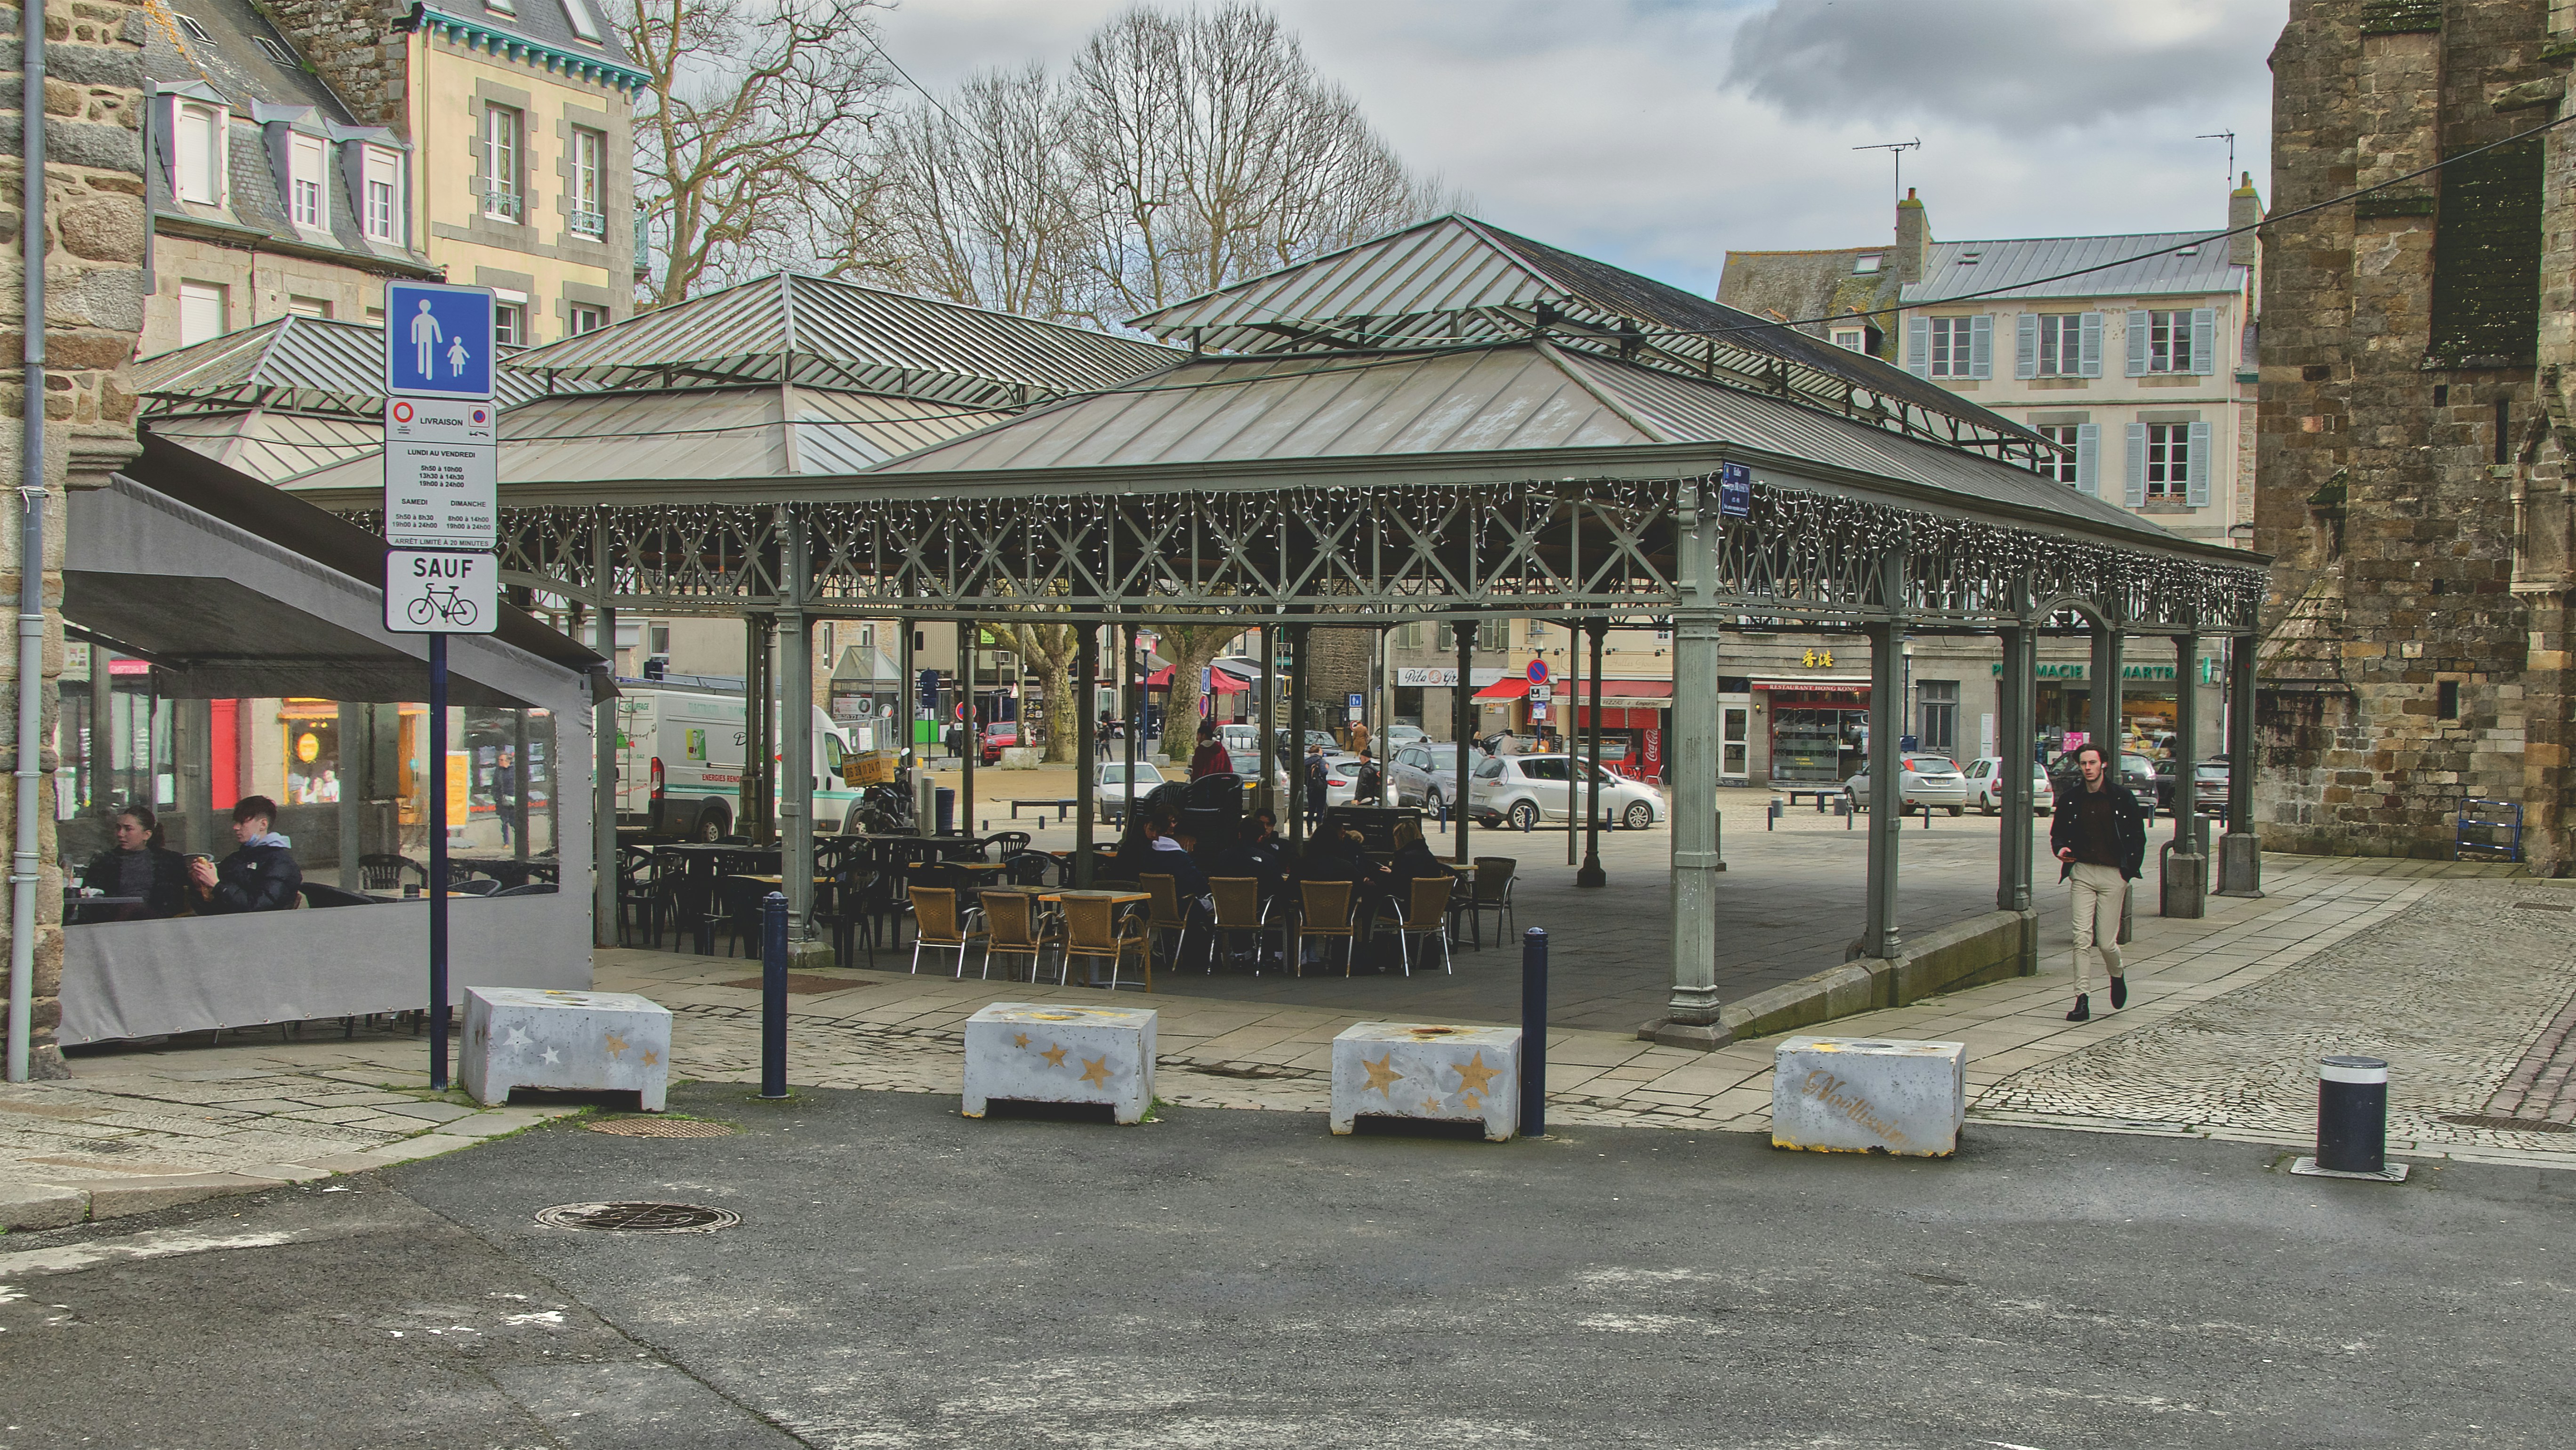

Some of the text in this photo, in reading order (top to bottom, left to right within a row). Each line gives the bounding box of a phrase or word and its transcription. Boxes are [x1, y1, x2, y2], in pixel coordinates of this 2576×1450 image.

[420, 418, 463, 426] LIVRAISON
[413, 557, 474, 578] SAUF
[1802, 648, 1834, 668] 香港
[1405, 669, 1427, 683] Pita
[1443, 670, 1458, 686] Gr
